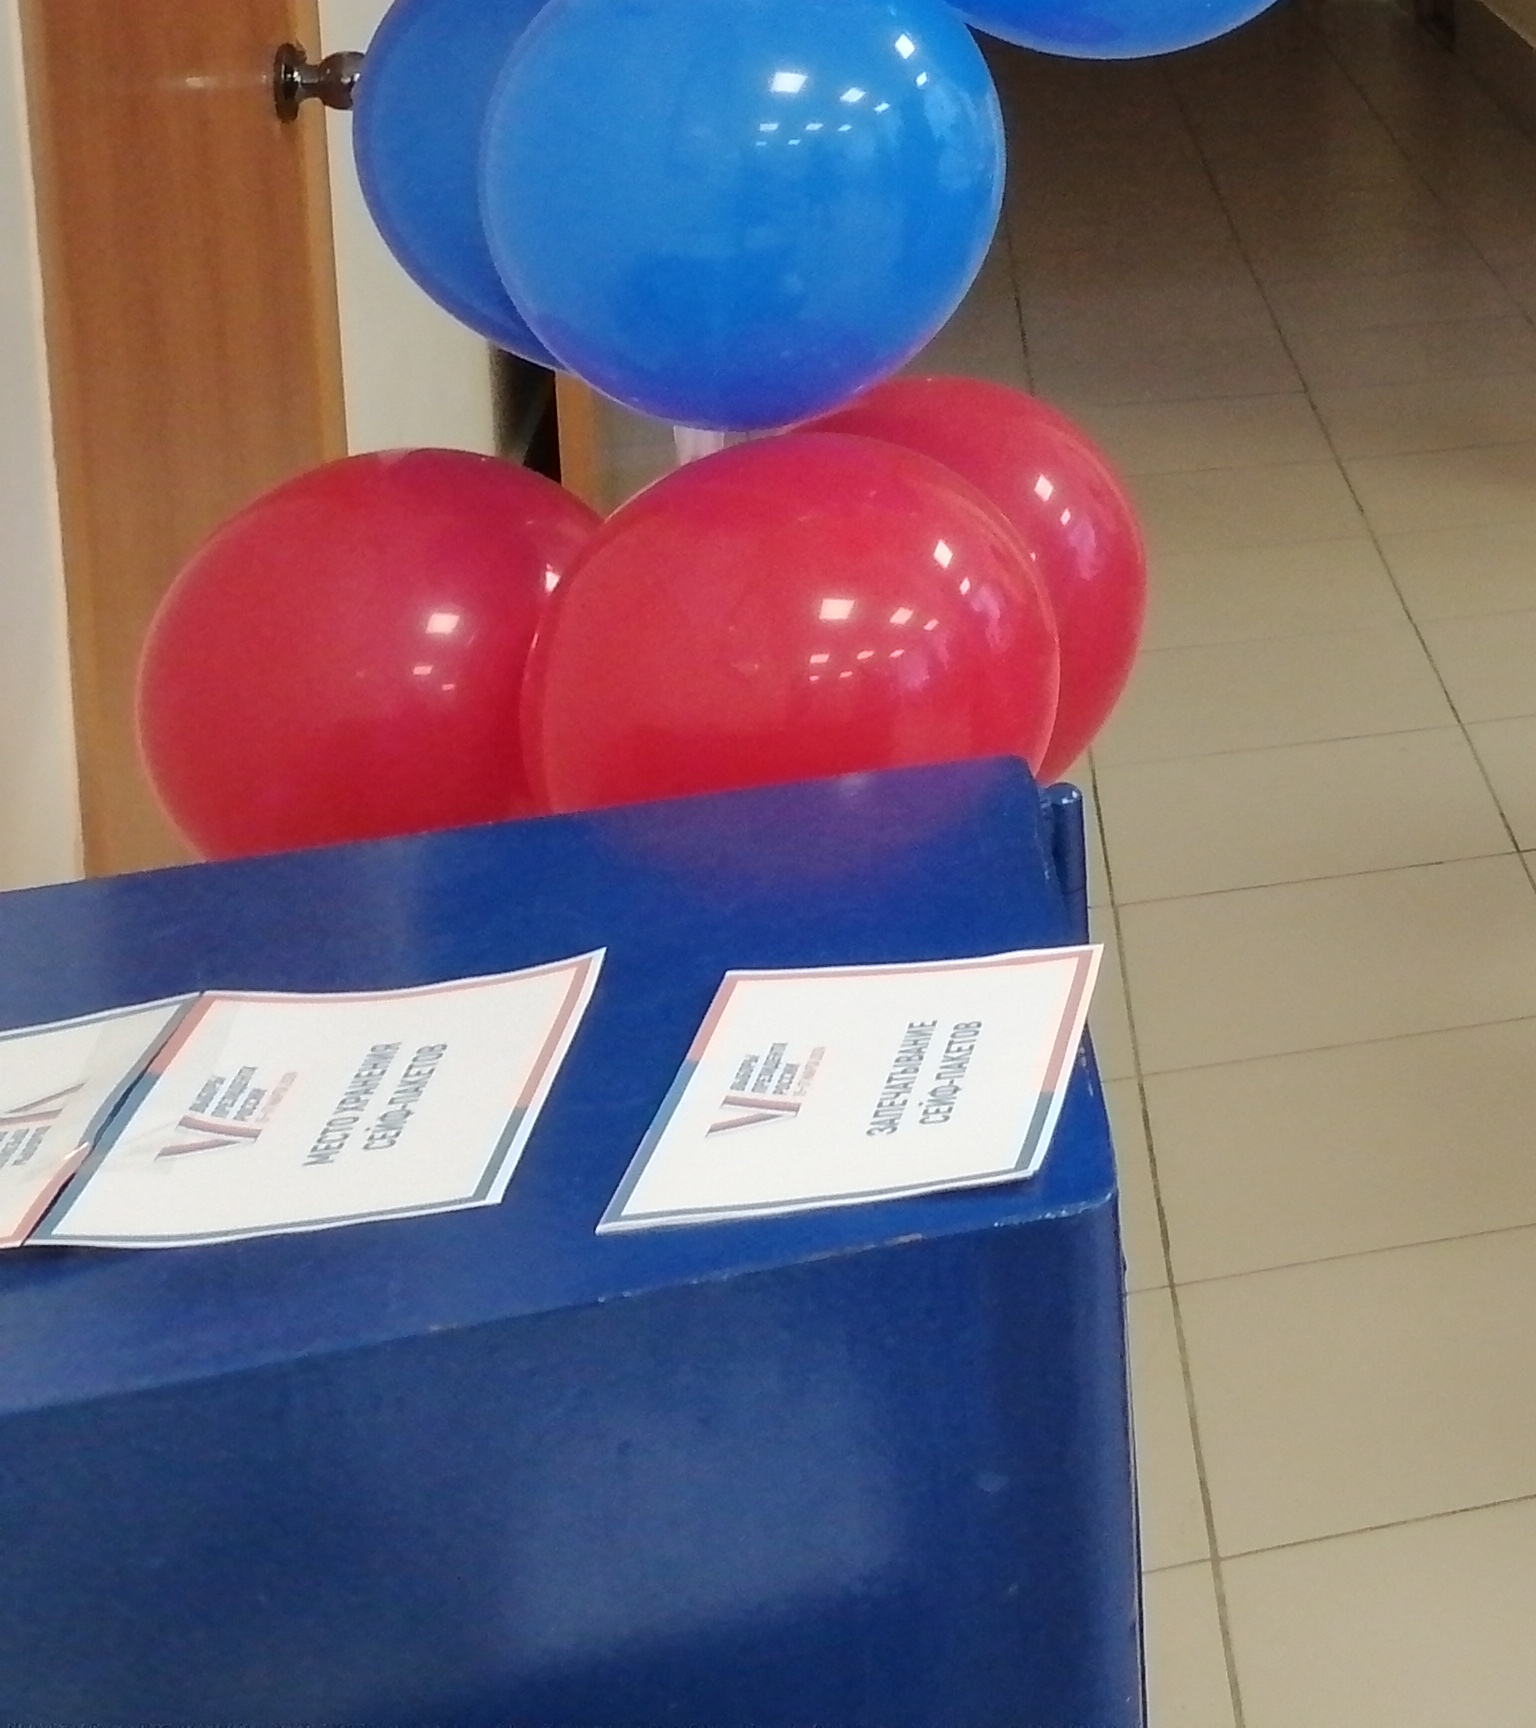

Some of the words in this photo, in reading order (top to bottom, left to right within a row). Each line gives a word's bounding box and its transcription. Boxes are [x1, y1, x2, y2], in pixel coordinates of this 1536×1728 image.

[302, 1115, 360, 1167] МЕСТО
[333, 1041, 402, 1115] ХРАНЕНИЯ
[362, 1043, 448, 1152] СЕЙФ-ПАКЕТОВ
[865, 1019, 938, 1136] ЗАПЕЧАТЫВАНИЕ
[918, 1020, 983, 1125] СЕЙФ-ПАКЕТОВ
